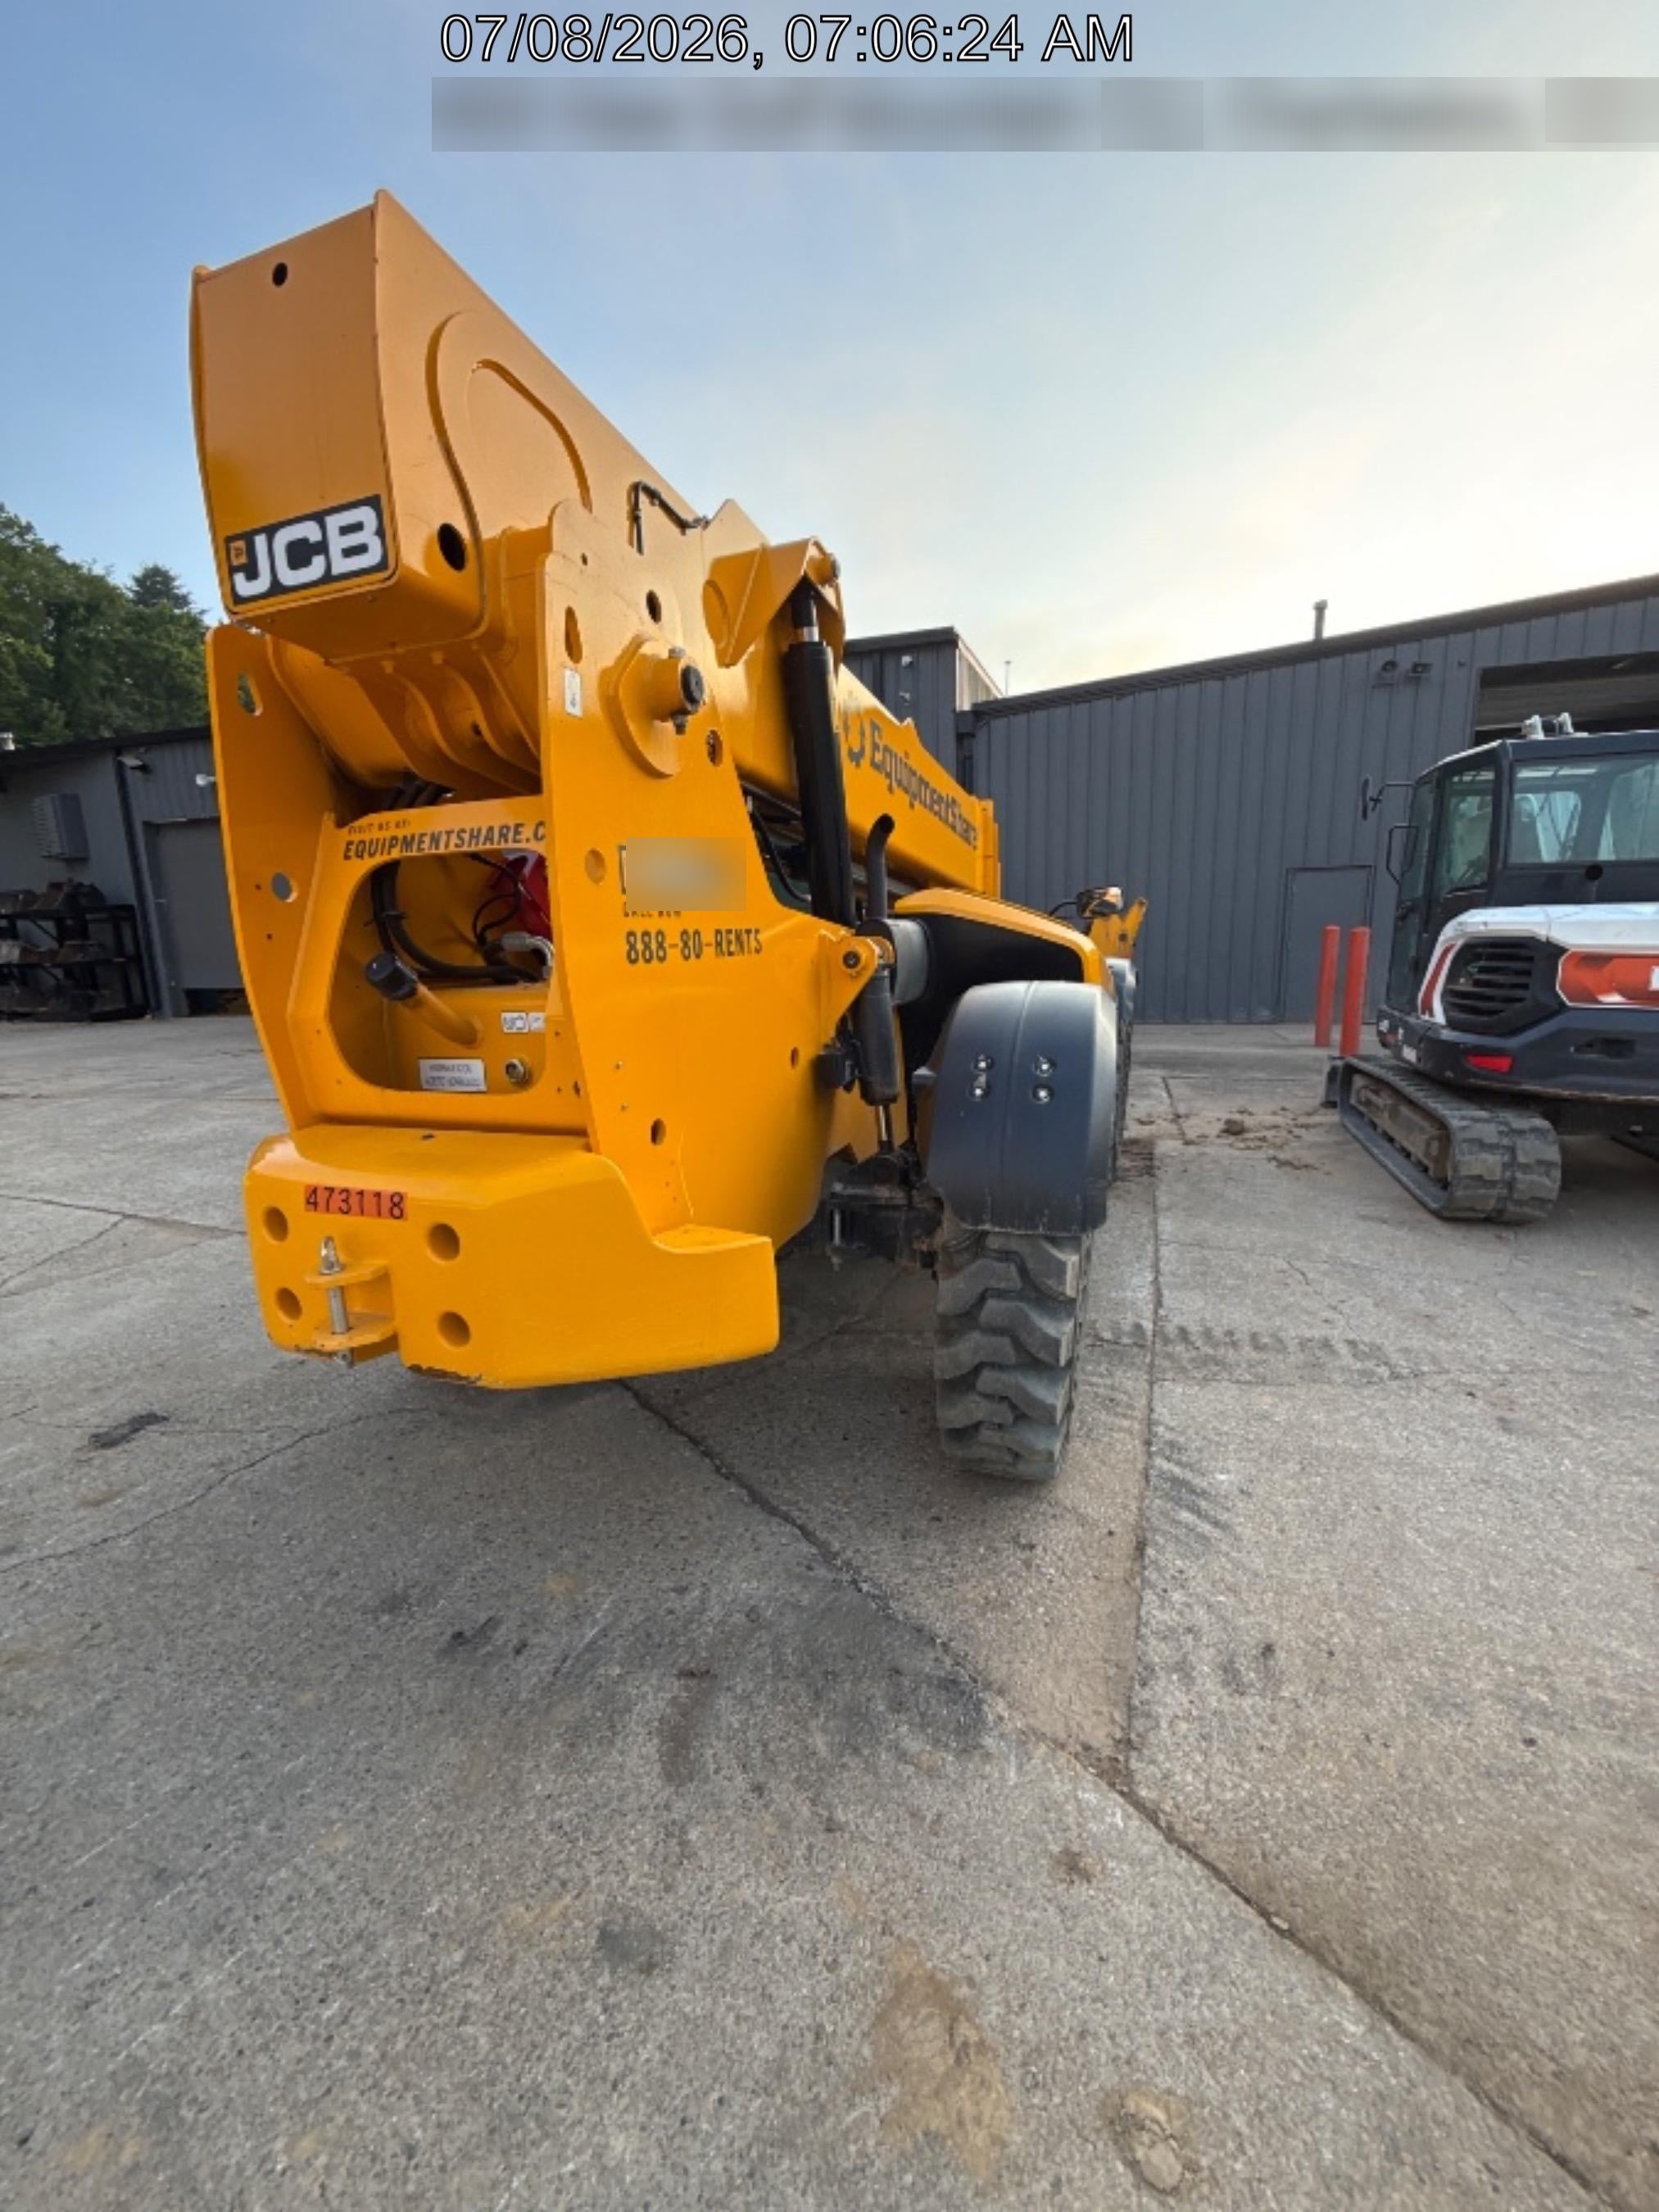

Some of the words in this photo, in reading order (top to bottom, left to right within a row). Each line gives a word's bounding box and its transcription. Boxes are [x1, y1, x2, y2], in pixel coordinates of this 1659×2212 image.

[232, 505, 383, 598] JCB
[626, 928, 763, 965] 888-80-RENTS
[306, 1186, 404, 1219] 473118
